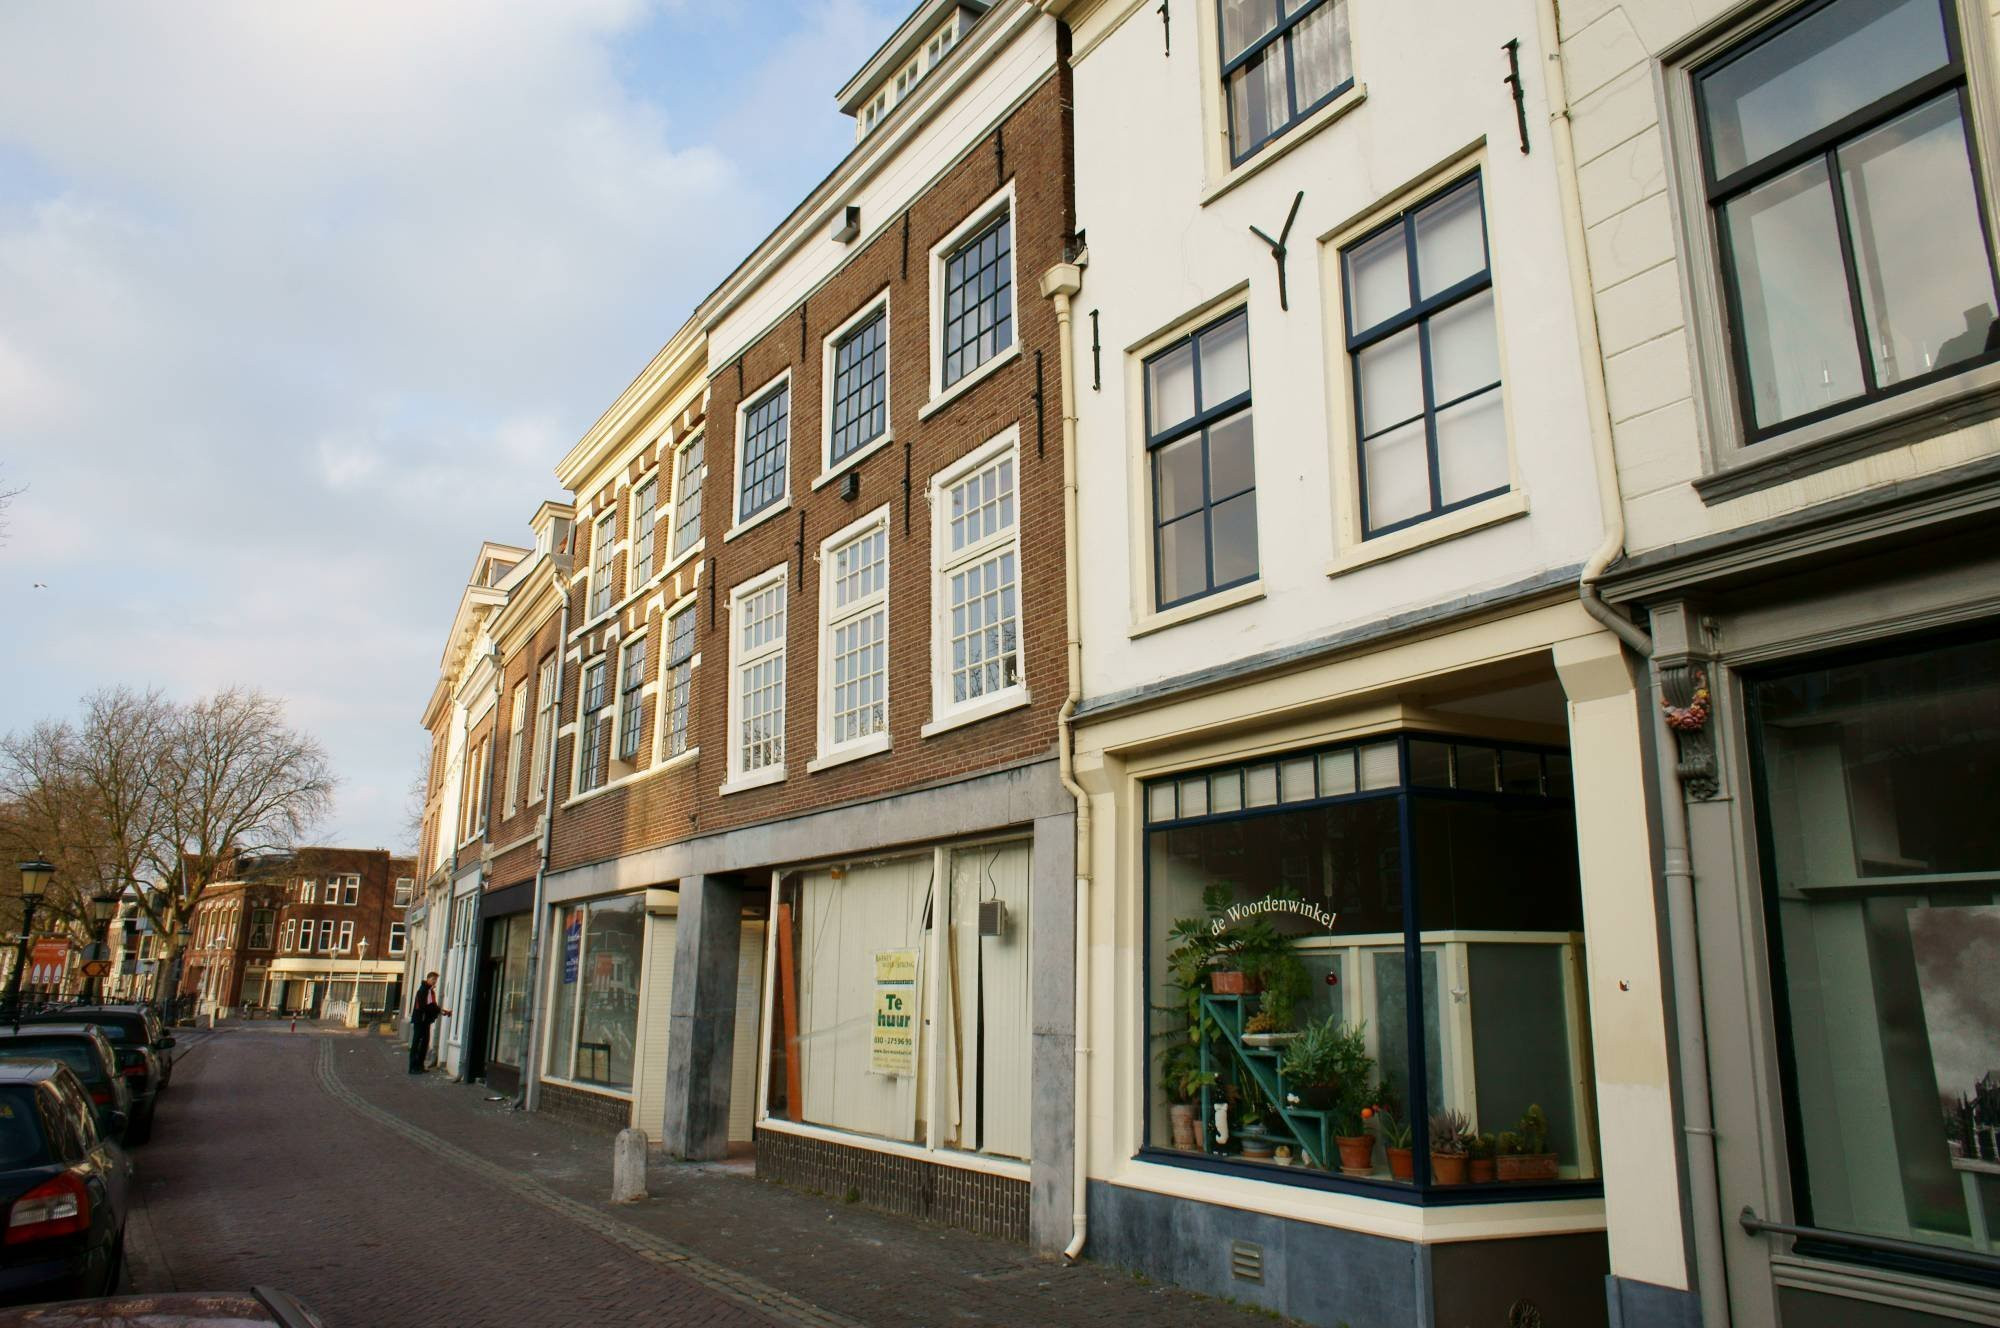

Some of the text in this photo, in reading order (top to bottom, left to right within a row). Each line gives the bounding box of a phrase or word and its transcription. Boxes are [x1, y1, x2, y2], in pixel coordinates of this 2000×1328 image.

[1211, 895, 1337, 936] de Woordenwinkel
[886, 994, 903, 1010] Te
[877, 1009, 911, 1028] huur
